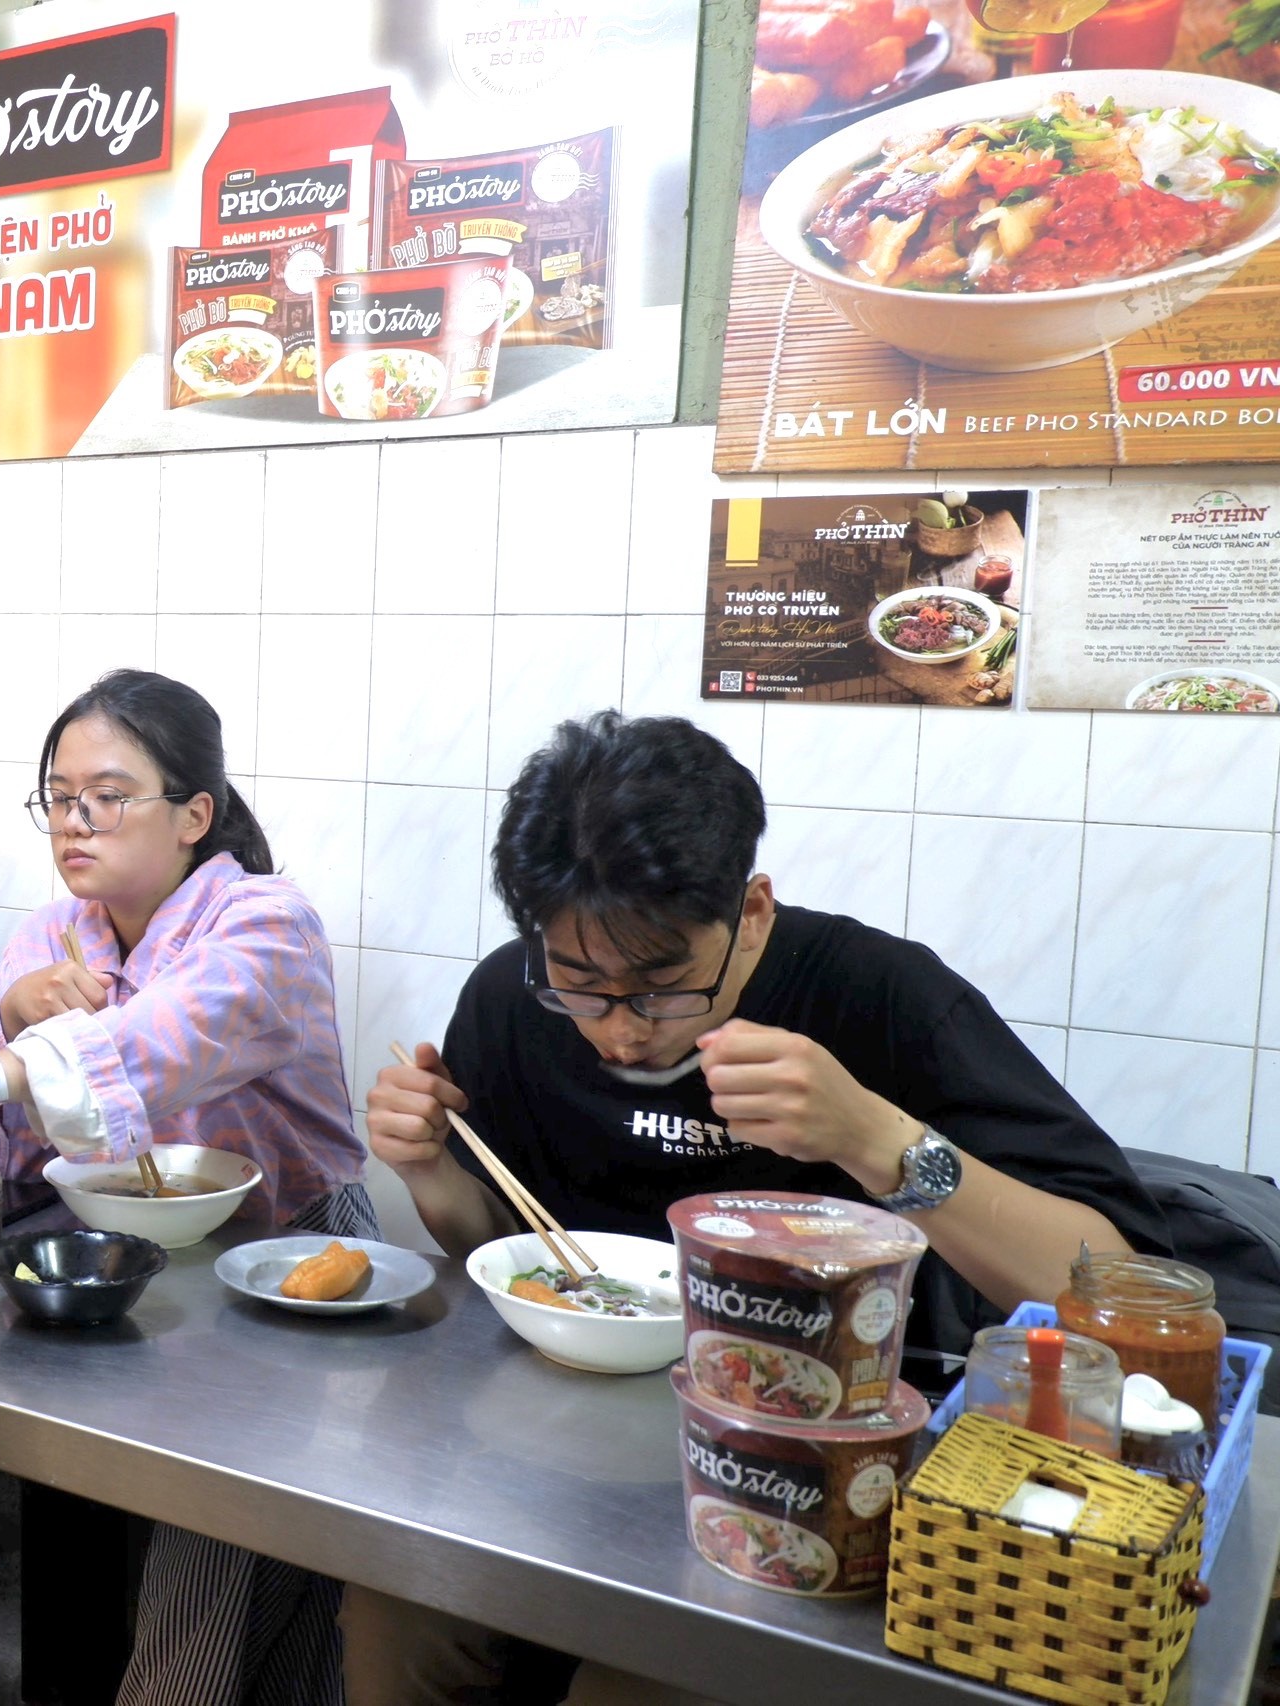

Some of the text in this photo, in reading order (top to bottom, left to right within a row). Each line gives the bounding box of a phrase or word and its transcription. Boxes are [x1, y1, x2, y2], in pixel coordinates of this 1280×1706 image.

[51, 193, 113, 248] PHỞ
[1137, 369, 1231, 392] 60.000
[774, 397, 1280, 438] BÁT LỚN BEEF PHO STANDARD BO
[1171, 503, 1270, 524] PHỞ THÌN
[814, 518, 908, 540] PHỞ THÌN
[1255, 540, 1270, 548] AN
[725, 589, 827, 605] THƯƠNG HIỆU
[724, 601, 840, 616] PHỞ CỔ TRUYỀN
[756, 685, 804, 693] PHOTHIN.VN
[662, 1141, 753, 1157] bachkhoa
